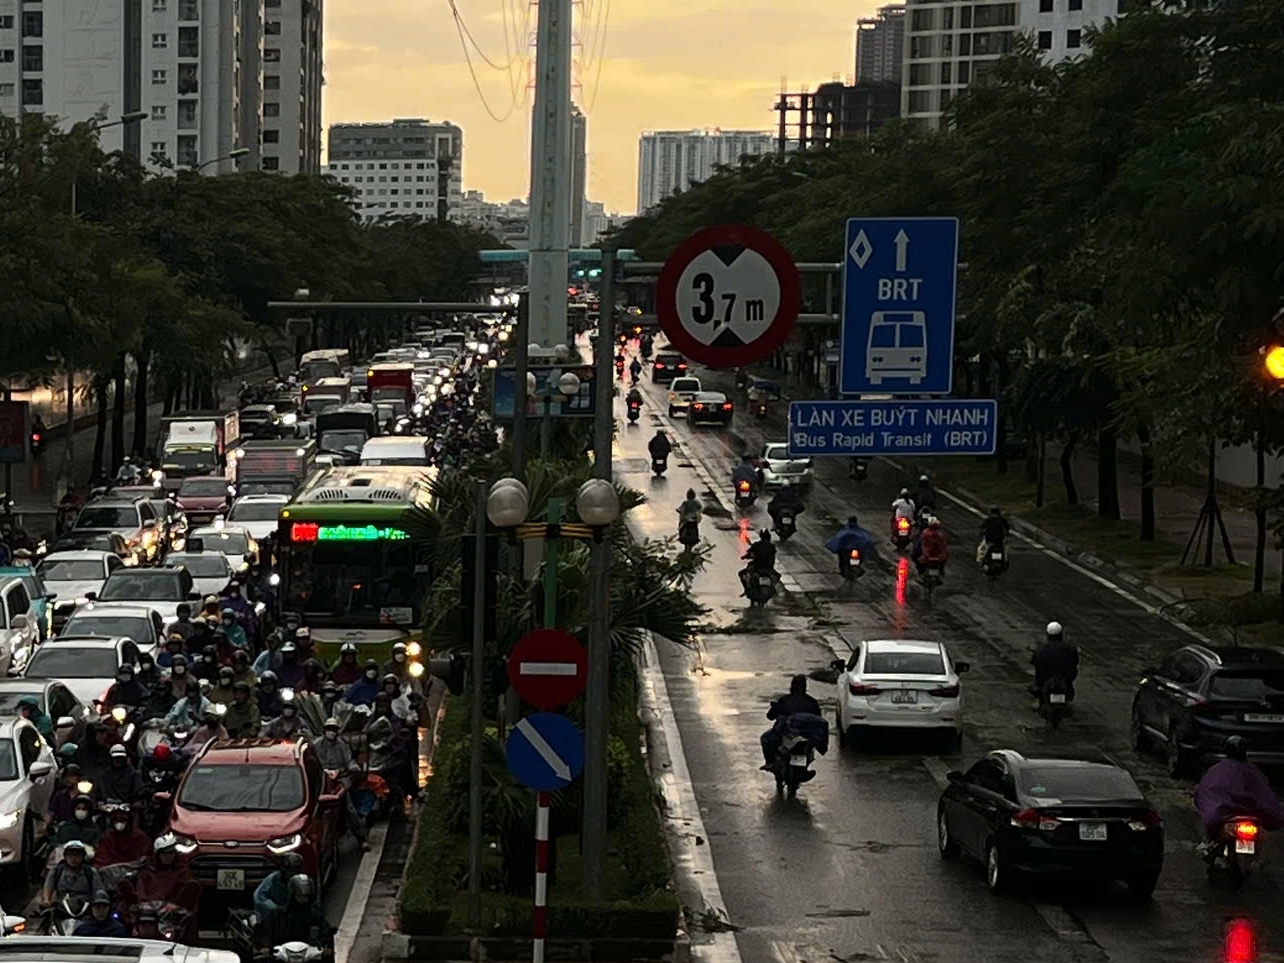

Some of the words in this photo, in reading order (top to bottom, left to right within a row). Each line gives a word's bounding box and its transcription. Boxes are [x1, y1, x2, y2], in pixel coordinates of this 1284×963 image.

[877, 277, 924, 301] BRT
[746, 299, 764, 321] m
[842, 409, 865, 426] XE
[871, 405, 916, 427] BUÝT
[925, 408, 989, 426] NHANH
[796, 432, 826, 448] Bus
[832, 432, 875, 449] Rapid
[883, 432, 932, 448] Transit
[943, 431, 989, 448] (BRT)
